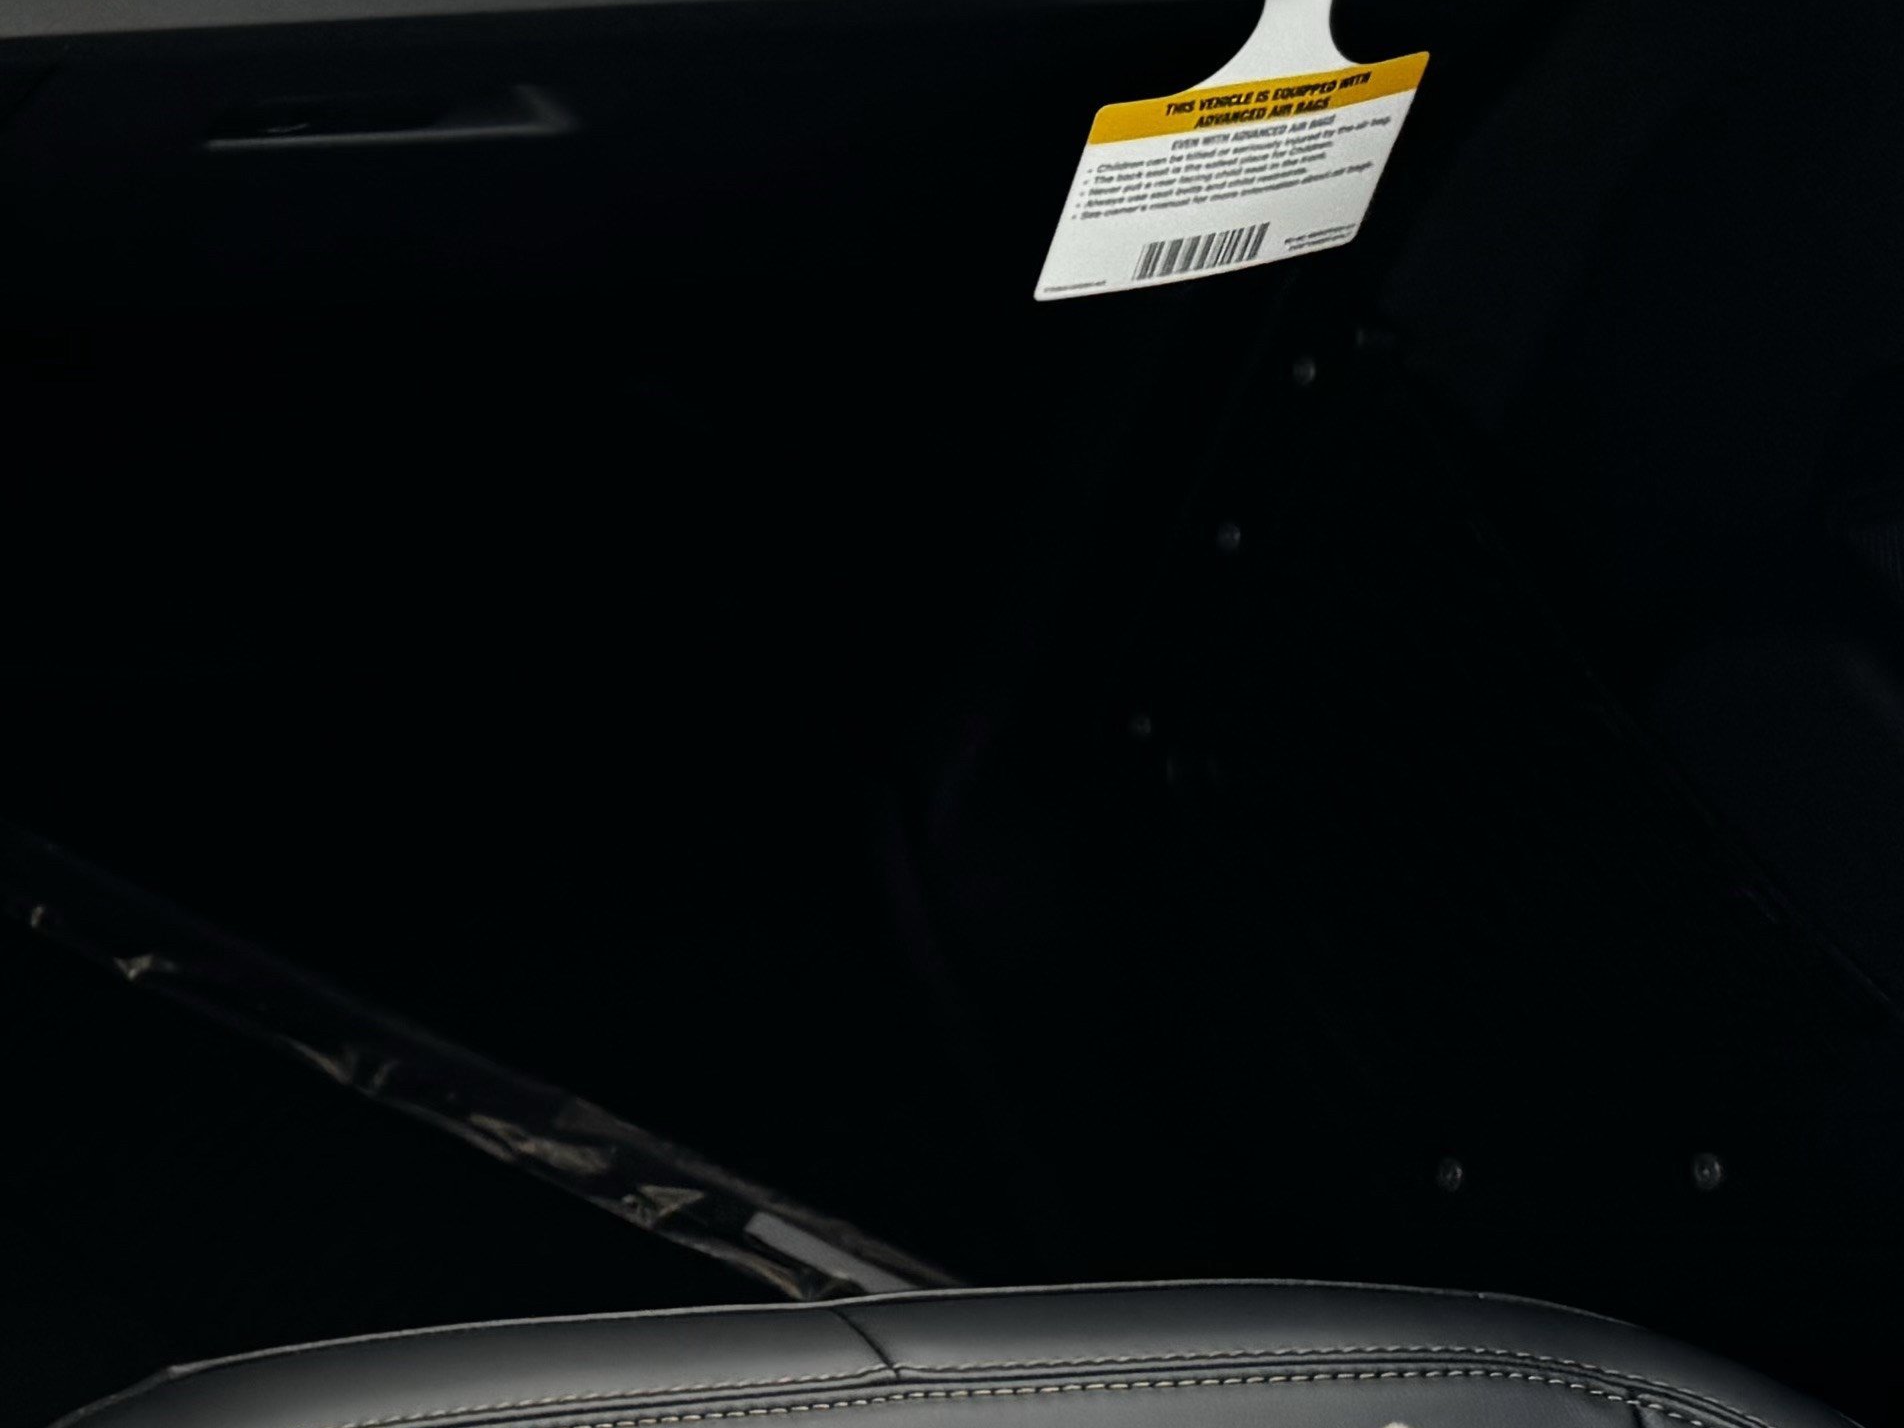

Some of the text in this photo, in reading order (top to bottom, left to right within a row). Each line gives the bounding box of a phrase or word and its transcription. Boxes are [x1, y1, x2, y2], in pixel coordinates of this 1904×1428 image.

[1166, 71, 1372, 116] THIS VEHICLE IS EQUIPPED WITH
[1194, 96, 1331, 129] ADVANCED AIR BAGS
[1202, 133, 1230, 145] WITH
[1231, 125, 1287, 141] ADVANCED
[1288, 122, 1307, 133] AIR
